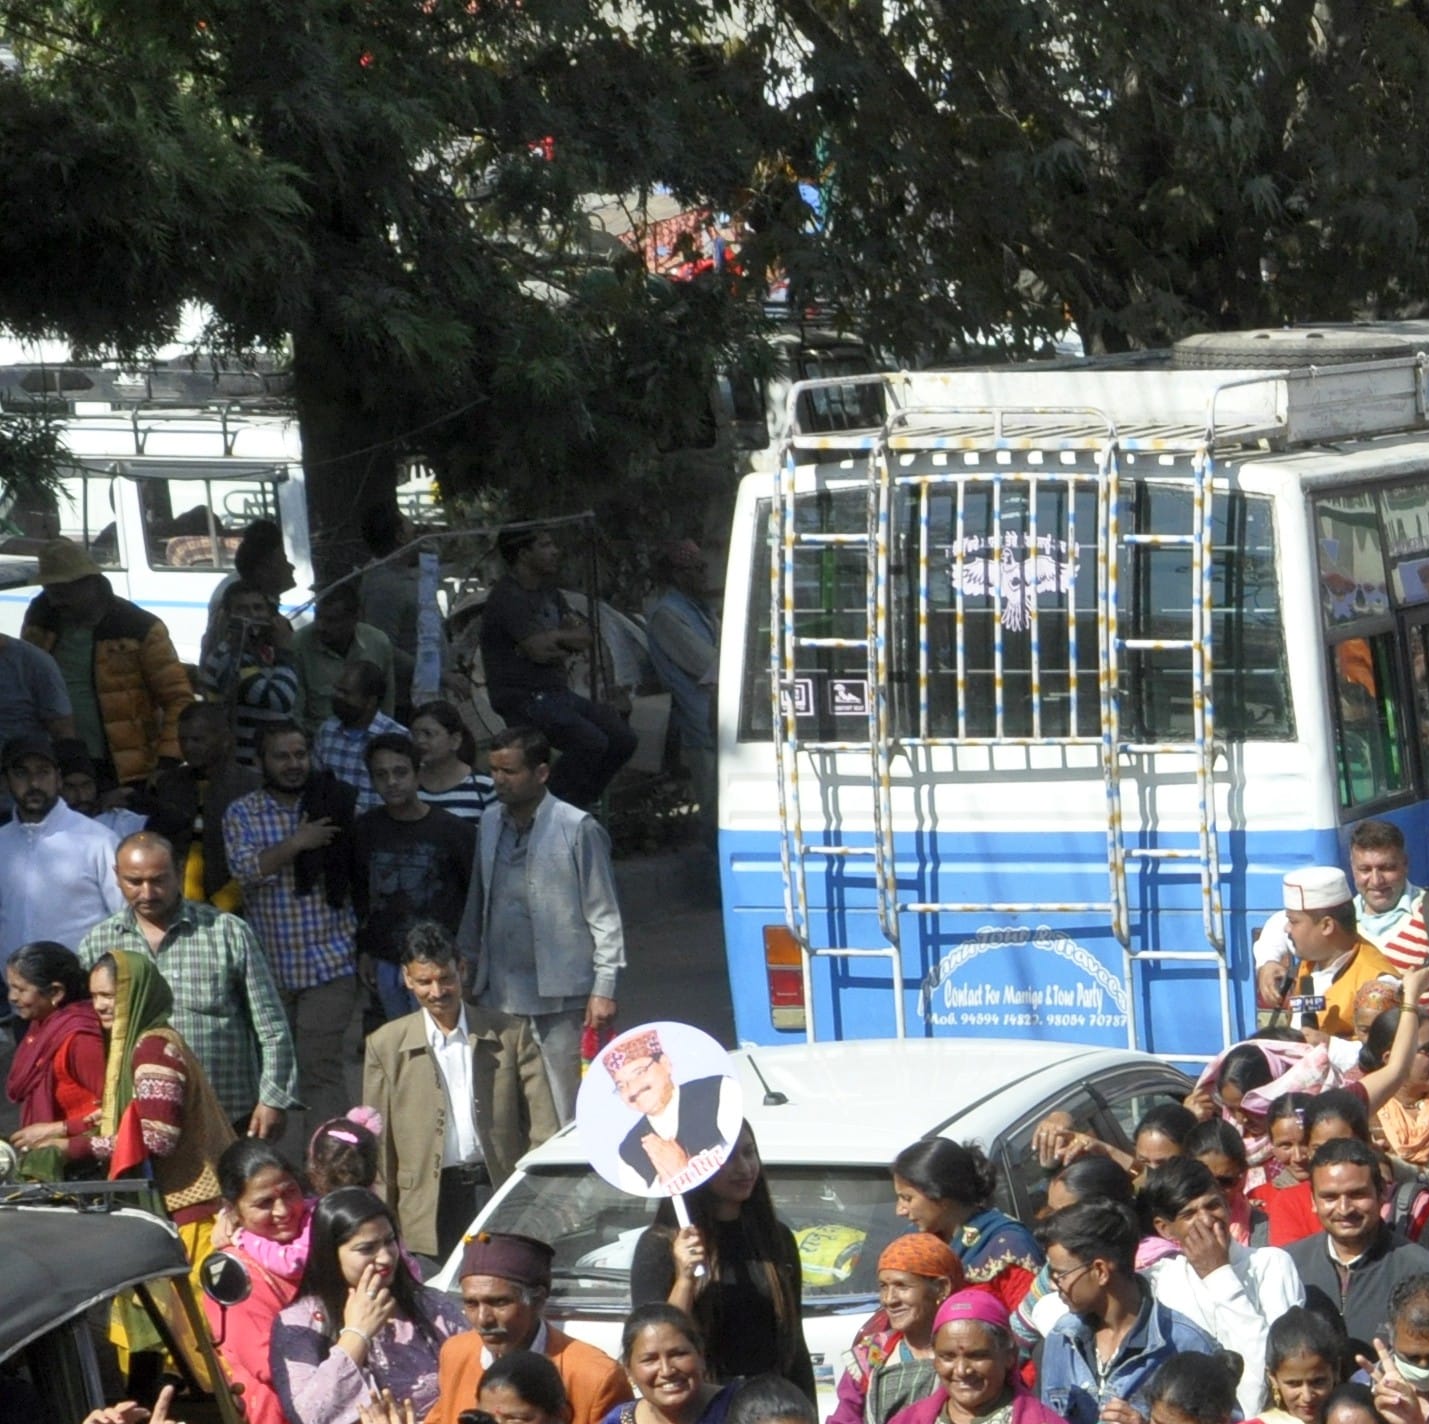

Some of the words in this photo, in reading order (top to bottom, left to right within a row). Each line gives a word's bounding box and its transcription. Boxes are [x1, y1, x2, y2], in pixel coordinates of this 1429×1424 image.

[944, 979, 983, 1008] Contact
[985, 983, 1000, 1006] For
[1077, 981, 1103, 1015] Party
[666, 1174, 692, 1195] राम
[693, 1149, 724, 1176] सिंह
